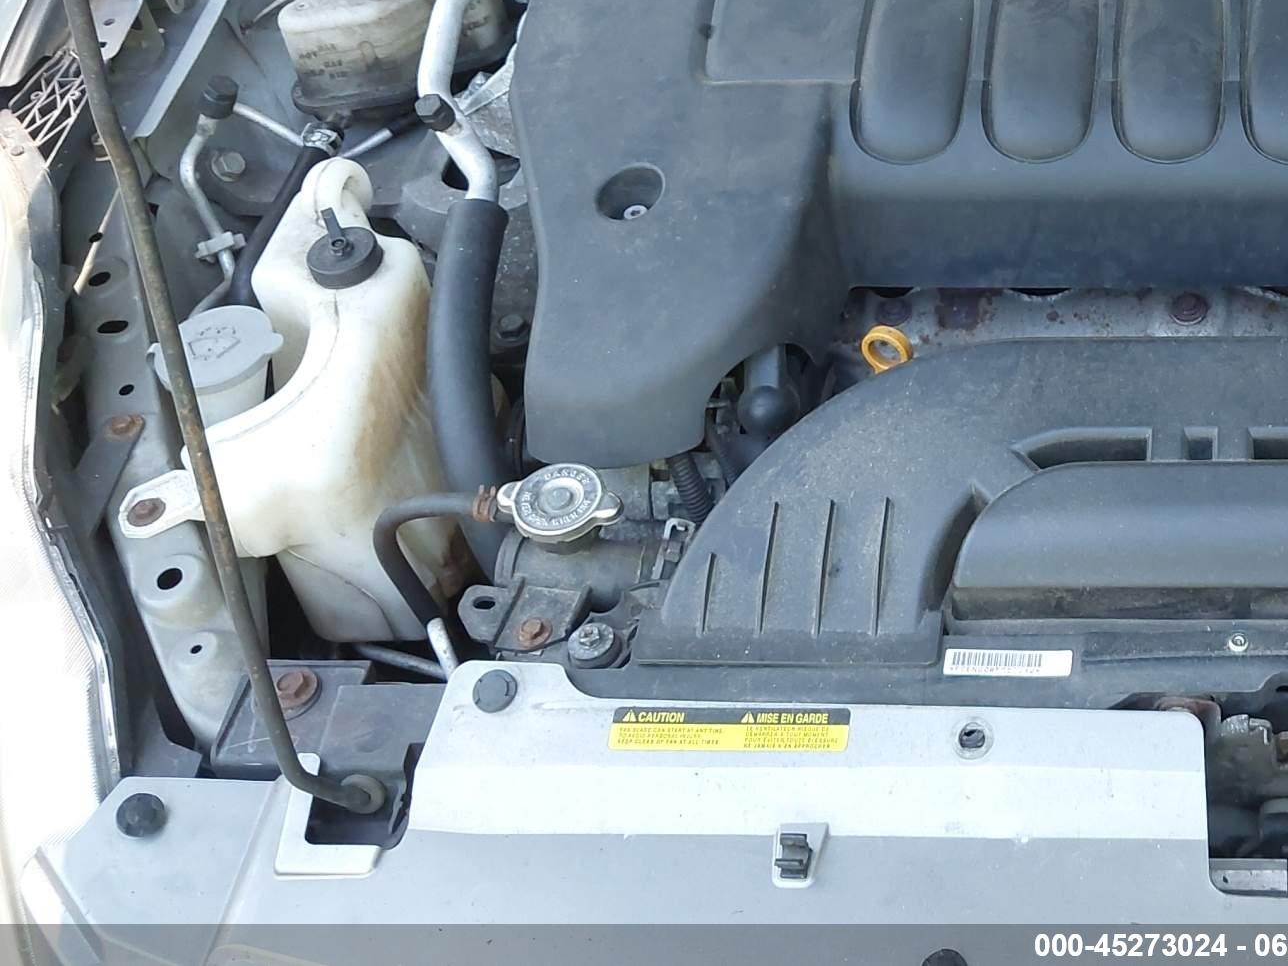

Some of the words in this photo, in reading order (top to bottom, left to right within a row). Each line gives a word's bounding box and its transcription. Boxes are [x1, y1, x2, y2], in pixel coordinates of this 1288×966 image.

[638, 712, 685, 724] CAUTION
[756, 712, 779, 724] MISE
[780, 713, 794, 724] EN
[795, 713, 829, 724] GARDE
